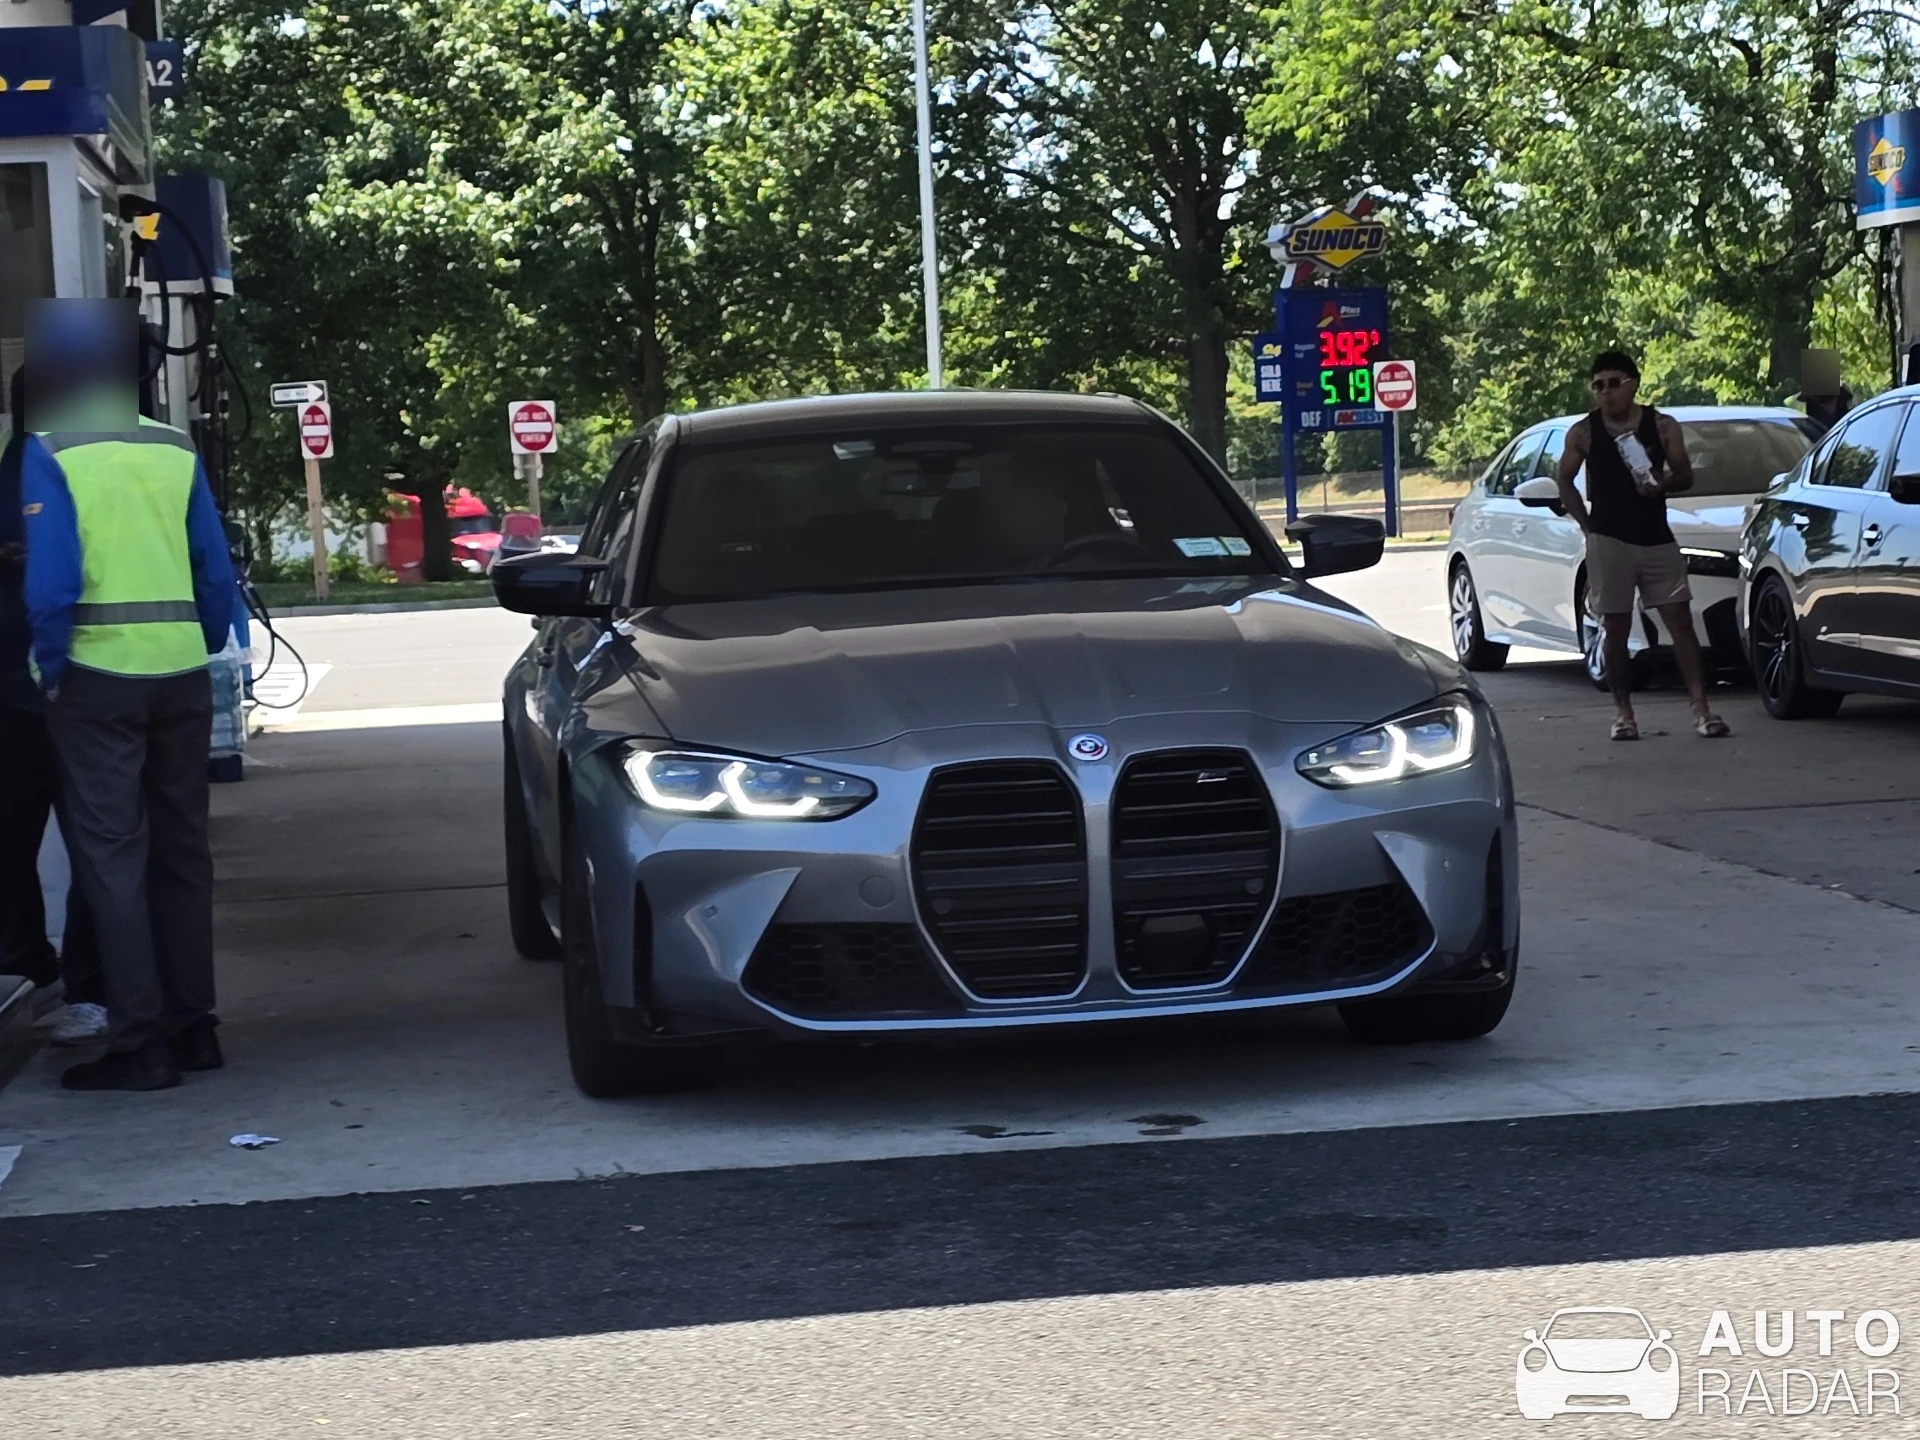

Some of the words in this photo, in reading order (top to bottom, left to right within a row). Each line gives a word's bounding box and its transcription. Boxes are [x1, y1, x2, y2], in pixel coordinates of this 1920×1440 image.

[1292, 227, 1383, 252] SUNOCO
[1320, 369, 1370, 405] 5.19
[1301, 411, 1321, 427] DEF
